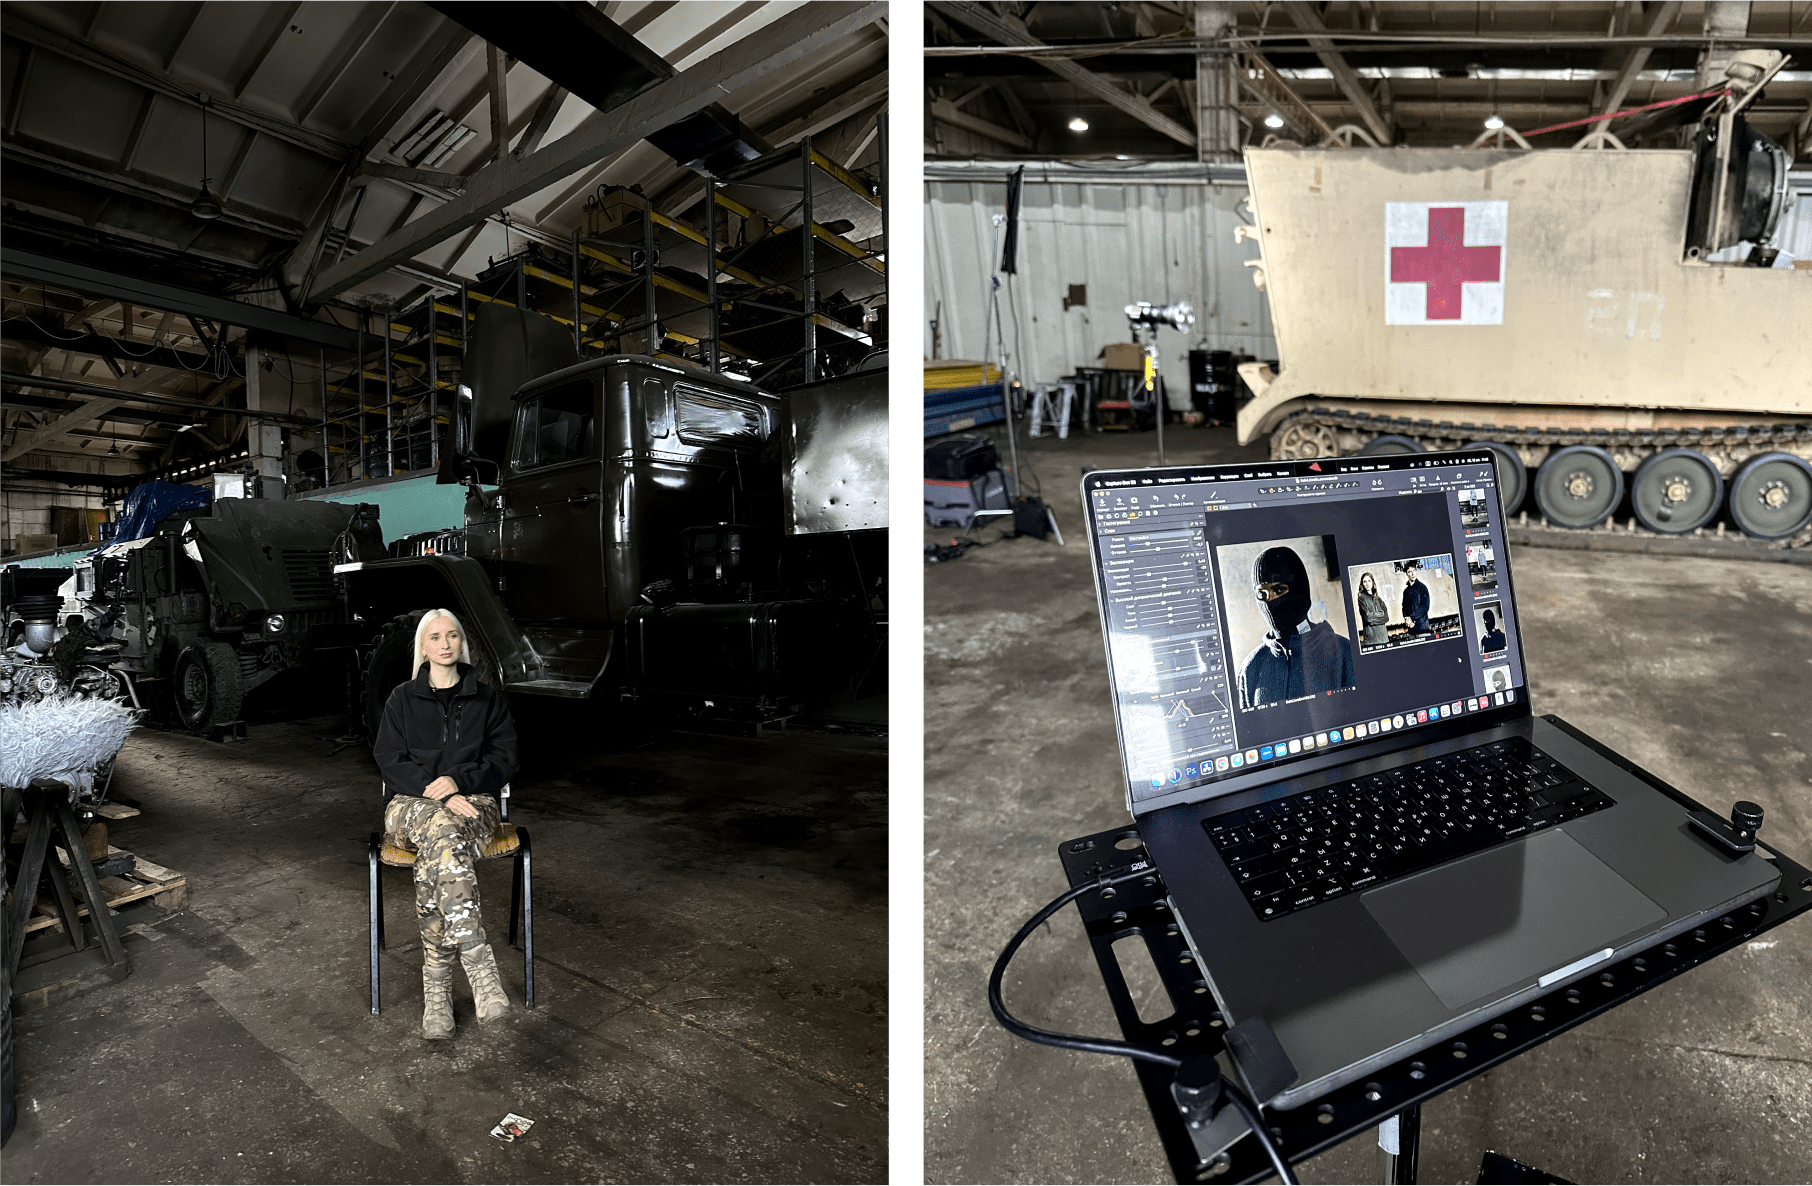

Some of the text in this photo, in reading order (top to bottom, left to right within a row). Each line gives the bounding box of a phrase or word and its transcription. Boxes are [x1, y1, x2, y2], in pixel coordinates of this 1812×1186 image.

[1186, 767, 1196, 776] Ps
[1352, 876, 1376, 886] command
[1326, 886, 1342, 894] option
[1296, 896, 1314, 904] control
